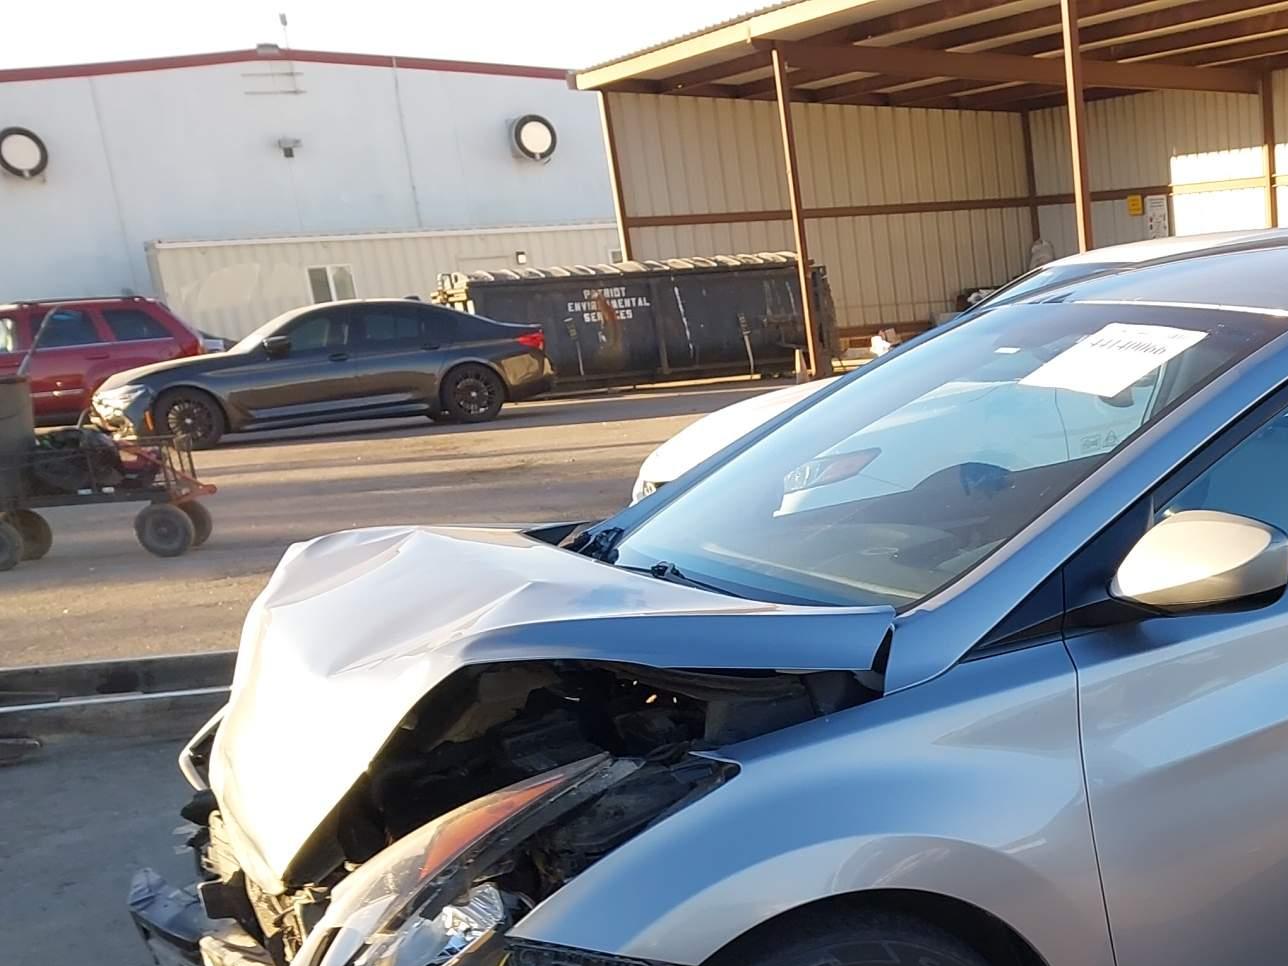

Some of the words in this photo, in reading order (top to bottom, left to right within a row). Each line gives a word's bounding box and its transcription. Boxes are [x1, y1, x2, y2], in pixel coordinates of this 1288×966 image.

[583, 287, 626, 299] PATRIOT
[568, 297, 650, 312] ENVIRMENTAL
[583, 309, 632, 322] SERES
